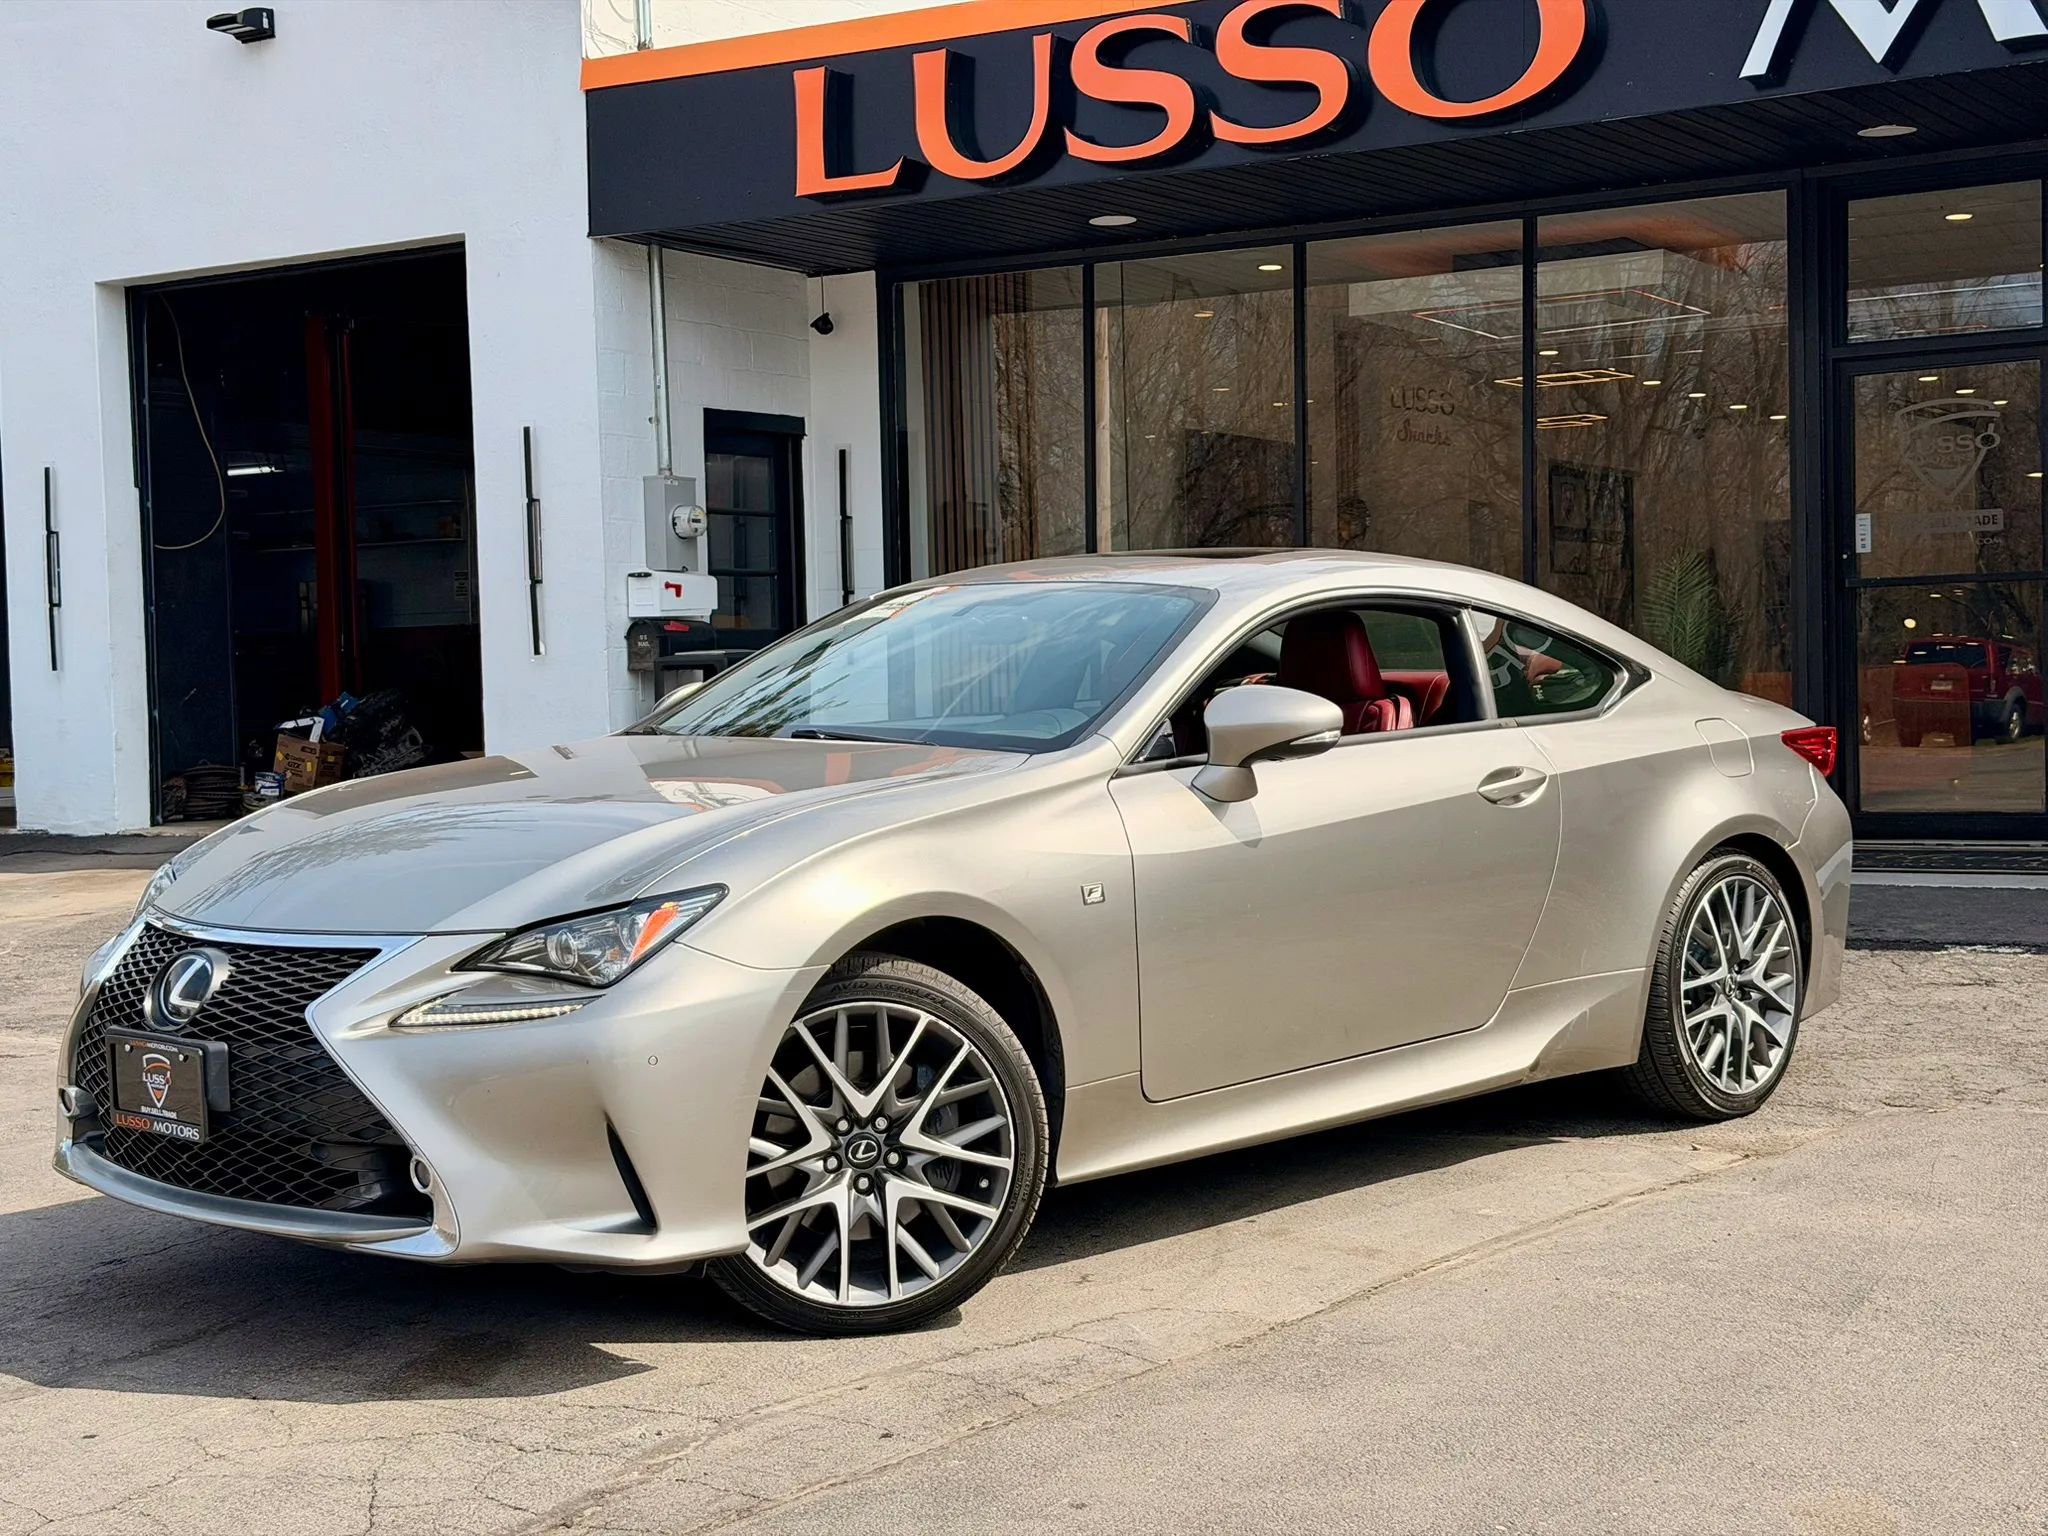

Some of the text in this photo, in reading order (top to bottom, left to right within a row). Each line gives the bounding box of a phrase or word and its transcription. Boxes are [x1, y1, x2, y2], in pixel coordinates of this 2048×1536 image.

[794, 0, 1588, 197] LUSSO
[1390, 385, 1455, 416] LUSSO
[831, 981, 869, 993] AVID
[115, 1113, 200, 1140] LUSSO MOTORS
